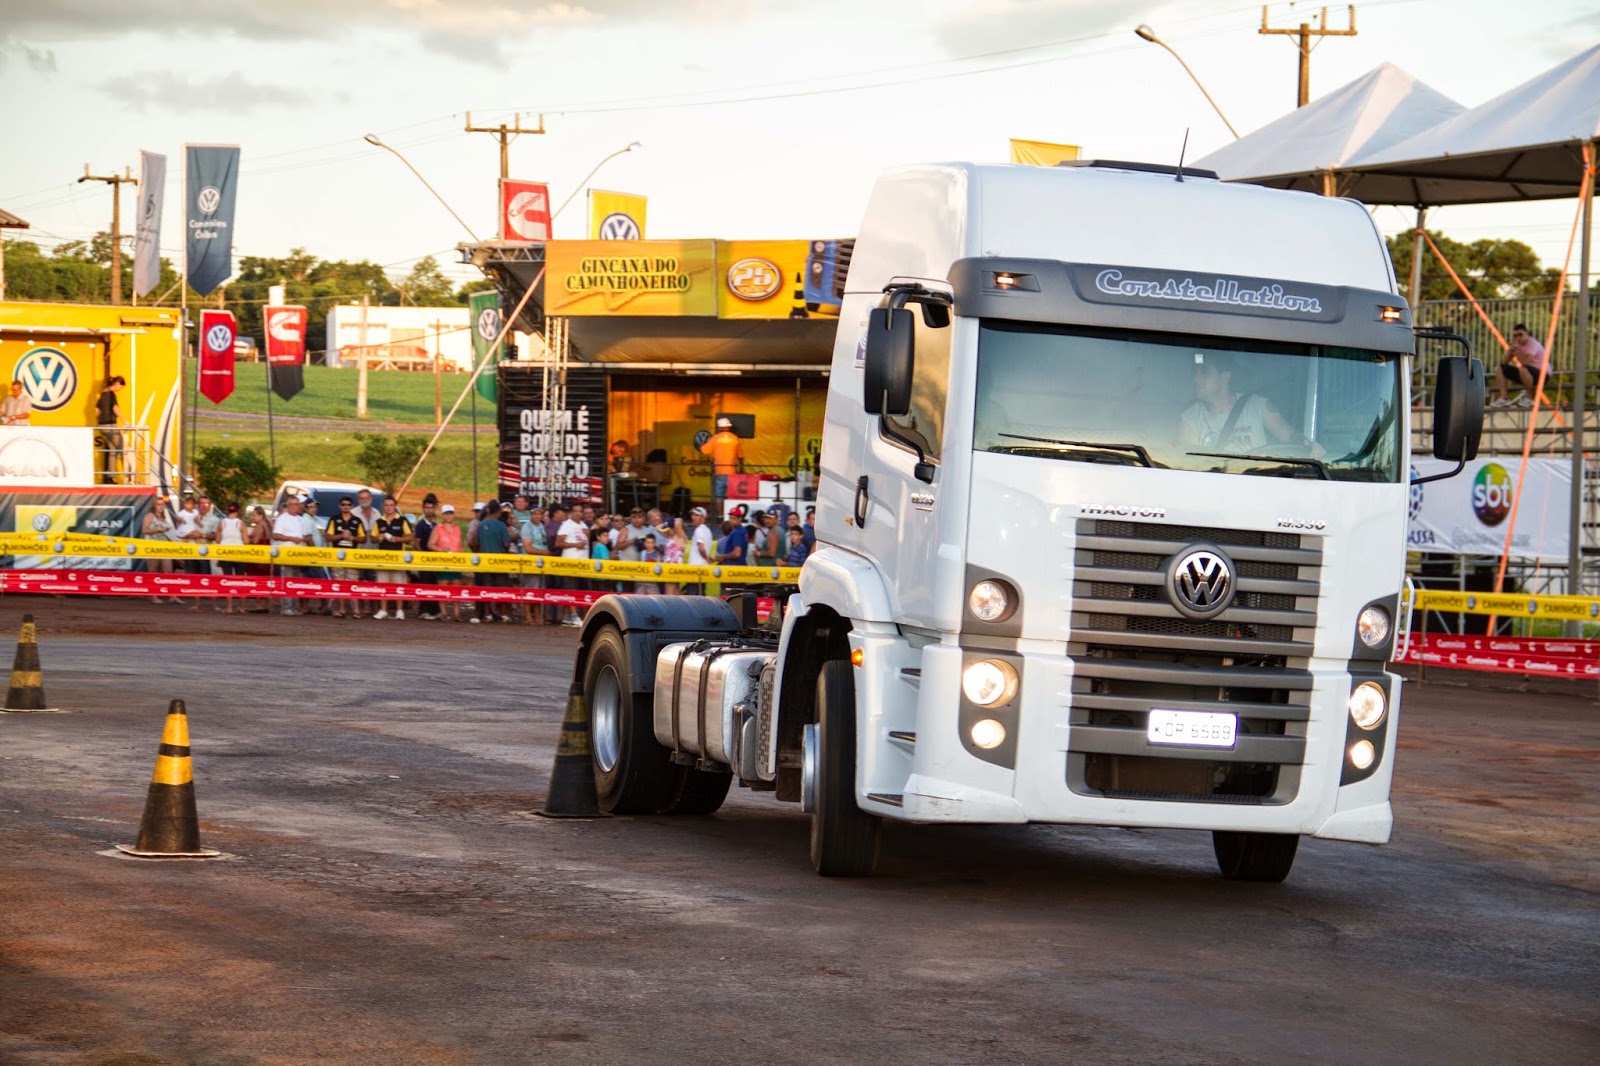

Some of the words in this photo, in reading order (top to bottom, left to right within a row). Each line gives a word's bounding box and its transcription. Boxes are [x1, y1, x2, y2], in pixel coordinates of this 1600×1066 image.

[581, 259, 653, 273] GINCANA
[655, 258, 676, 273] DO
[566, 274, 688, 290] CAMINHONEIRO
[733, 267, 772, 286] 25
[1096, 269, 1323, 313] Constellation
[520, 409, 572, 432] QUEM
[577, 405, 589, 431] É
[565, 434, 589, 454] DE
[1474, 474, 1510, 509] sbt
[85, 520, 123, 529] MAN
[1079, 503, 1166, 518] TRACTOR
[1275, 516, 1326, 531] 19.330
[72, 542, 122, 554] CAMINHÕES
[144, 546, 193, 555] CAMINHÕES
[216, 547, 265, 556] CAMINHÕES
[286, 550, 332, 559] CAMINHÕES
[353, 552, 399, 562] CAMINHÕES
[421, 556, 467, 565] CAMINHÕES
[550, 561, 590, 571] CAMINHÕES
[609, 564, 650, 574] CAMINHÕES
[727, 570, 767, 578] CAMINHÕES
[1482, 601, 1524, 612] CAMINHÕES
[1544, 604, 1586, 615] CAMINHÕES
